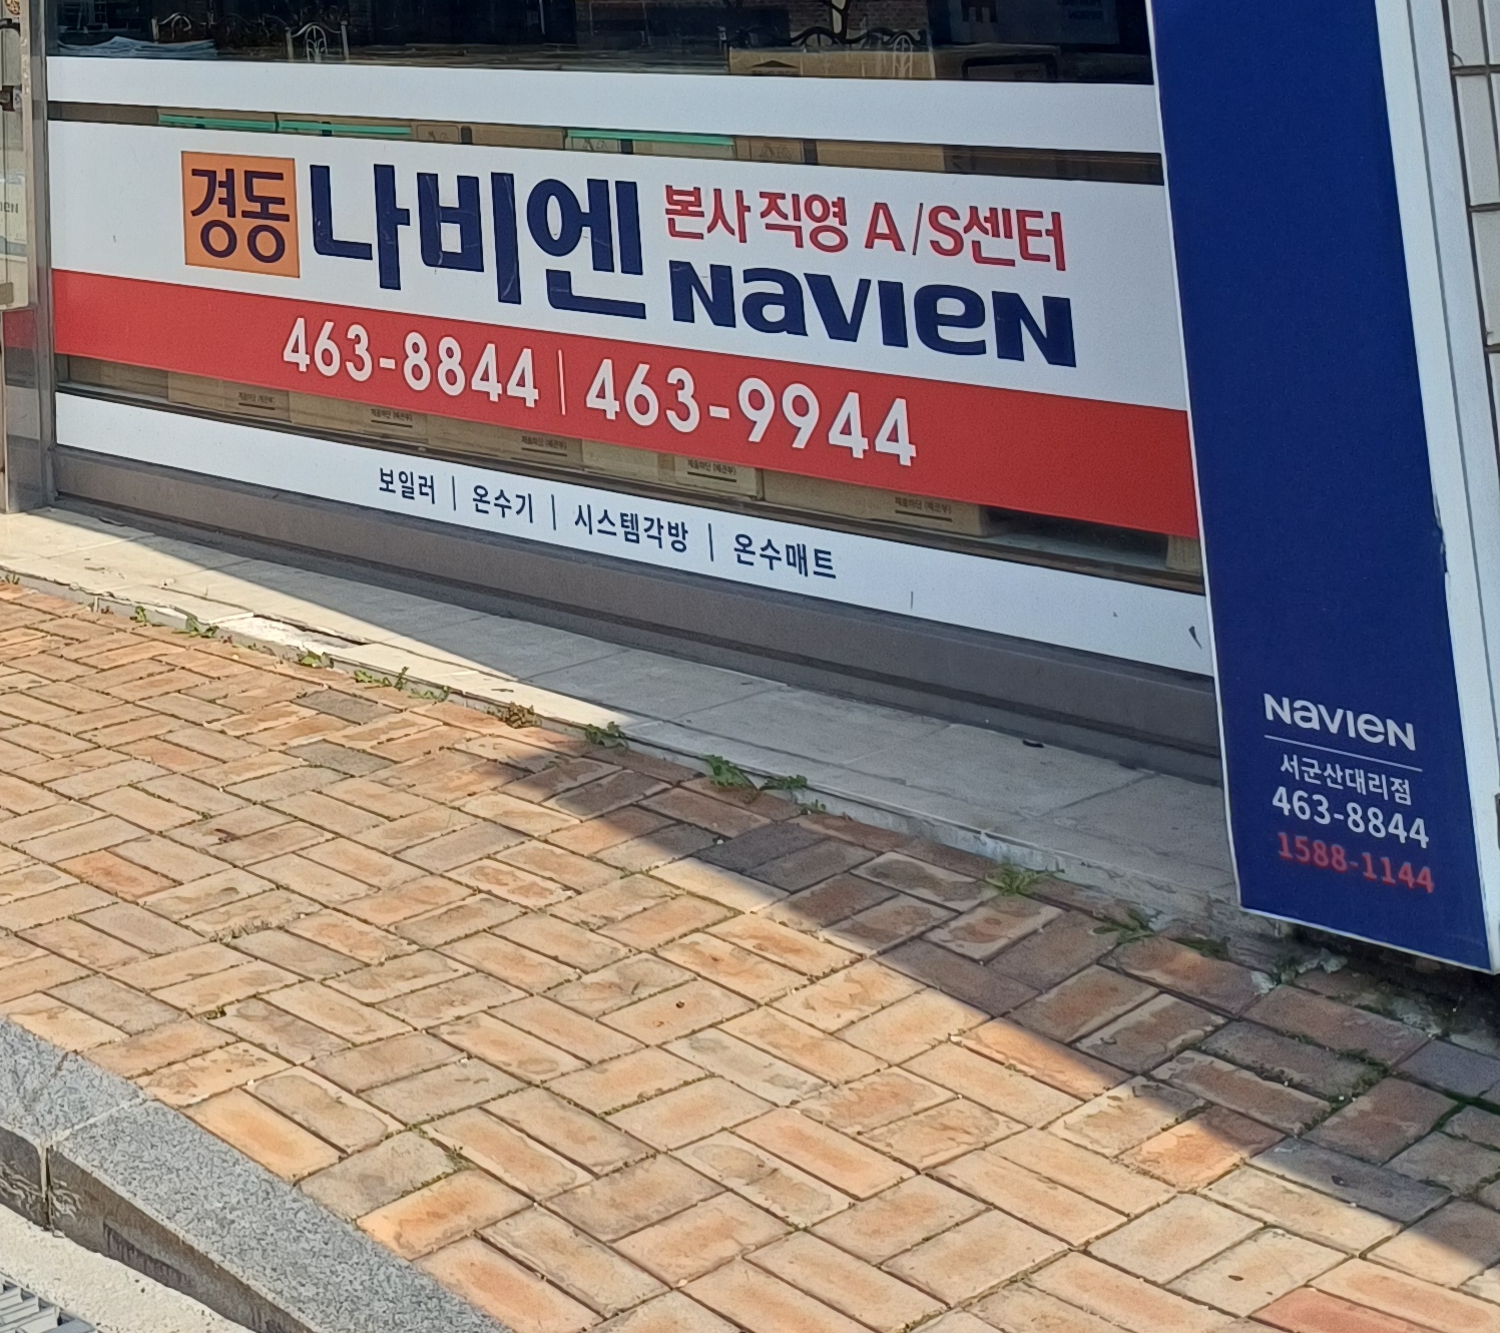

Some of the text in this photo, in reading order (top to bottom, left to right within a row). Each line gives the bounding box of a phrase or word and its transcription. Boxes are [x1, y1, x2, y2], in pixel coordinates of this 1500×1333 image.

[188, 167, 292, 264] 경동
[308, 162, 648, 321] 나비엔
[282, 316, 917, 469] 463-8844 463-9944
[378, 466, 838, 580] 보일러 온수기 시스템각방 온수매트
[1271, 786, 1430, 849] 463-8844
[1280, 753, 1412, 806] 서군산대리점
[1277, 831, 1435, 894] 1588-1144
